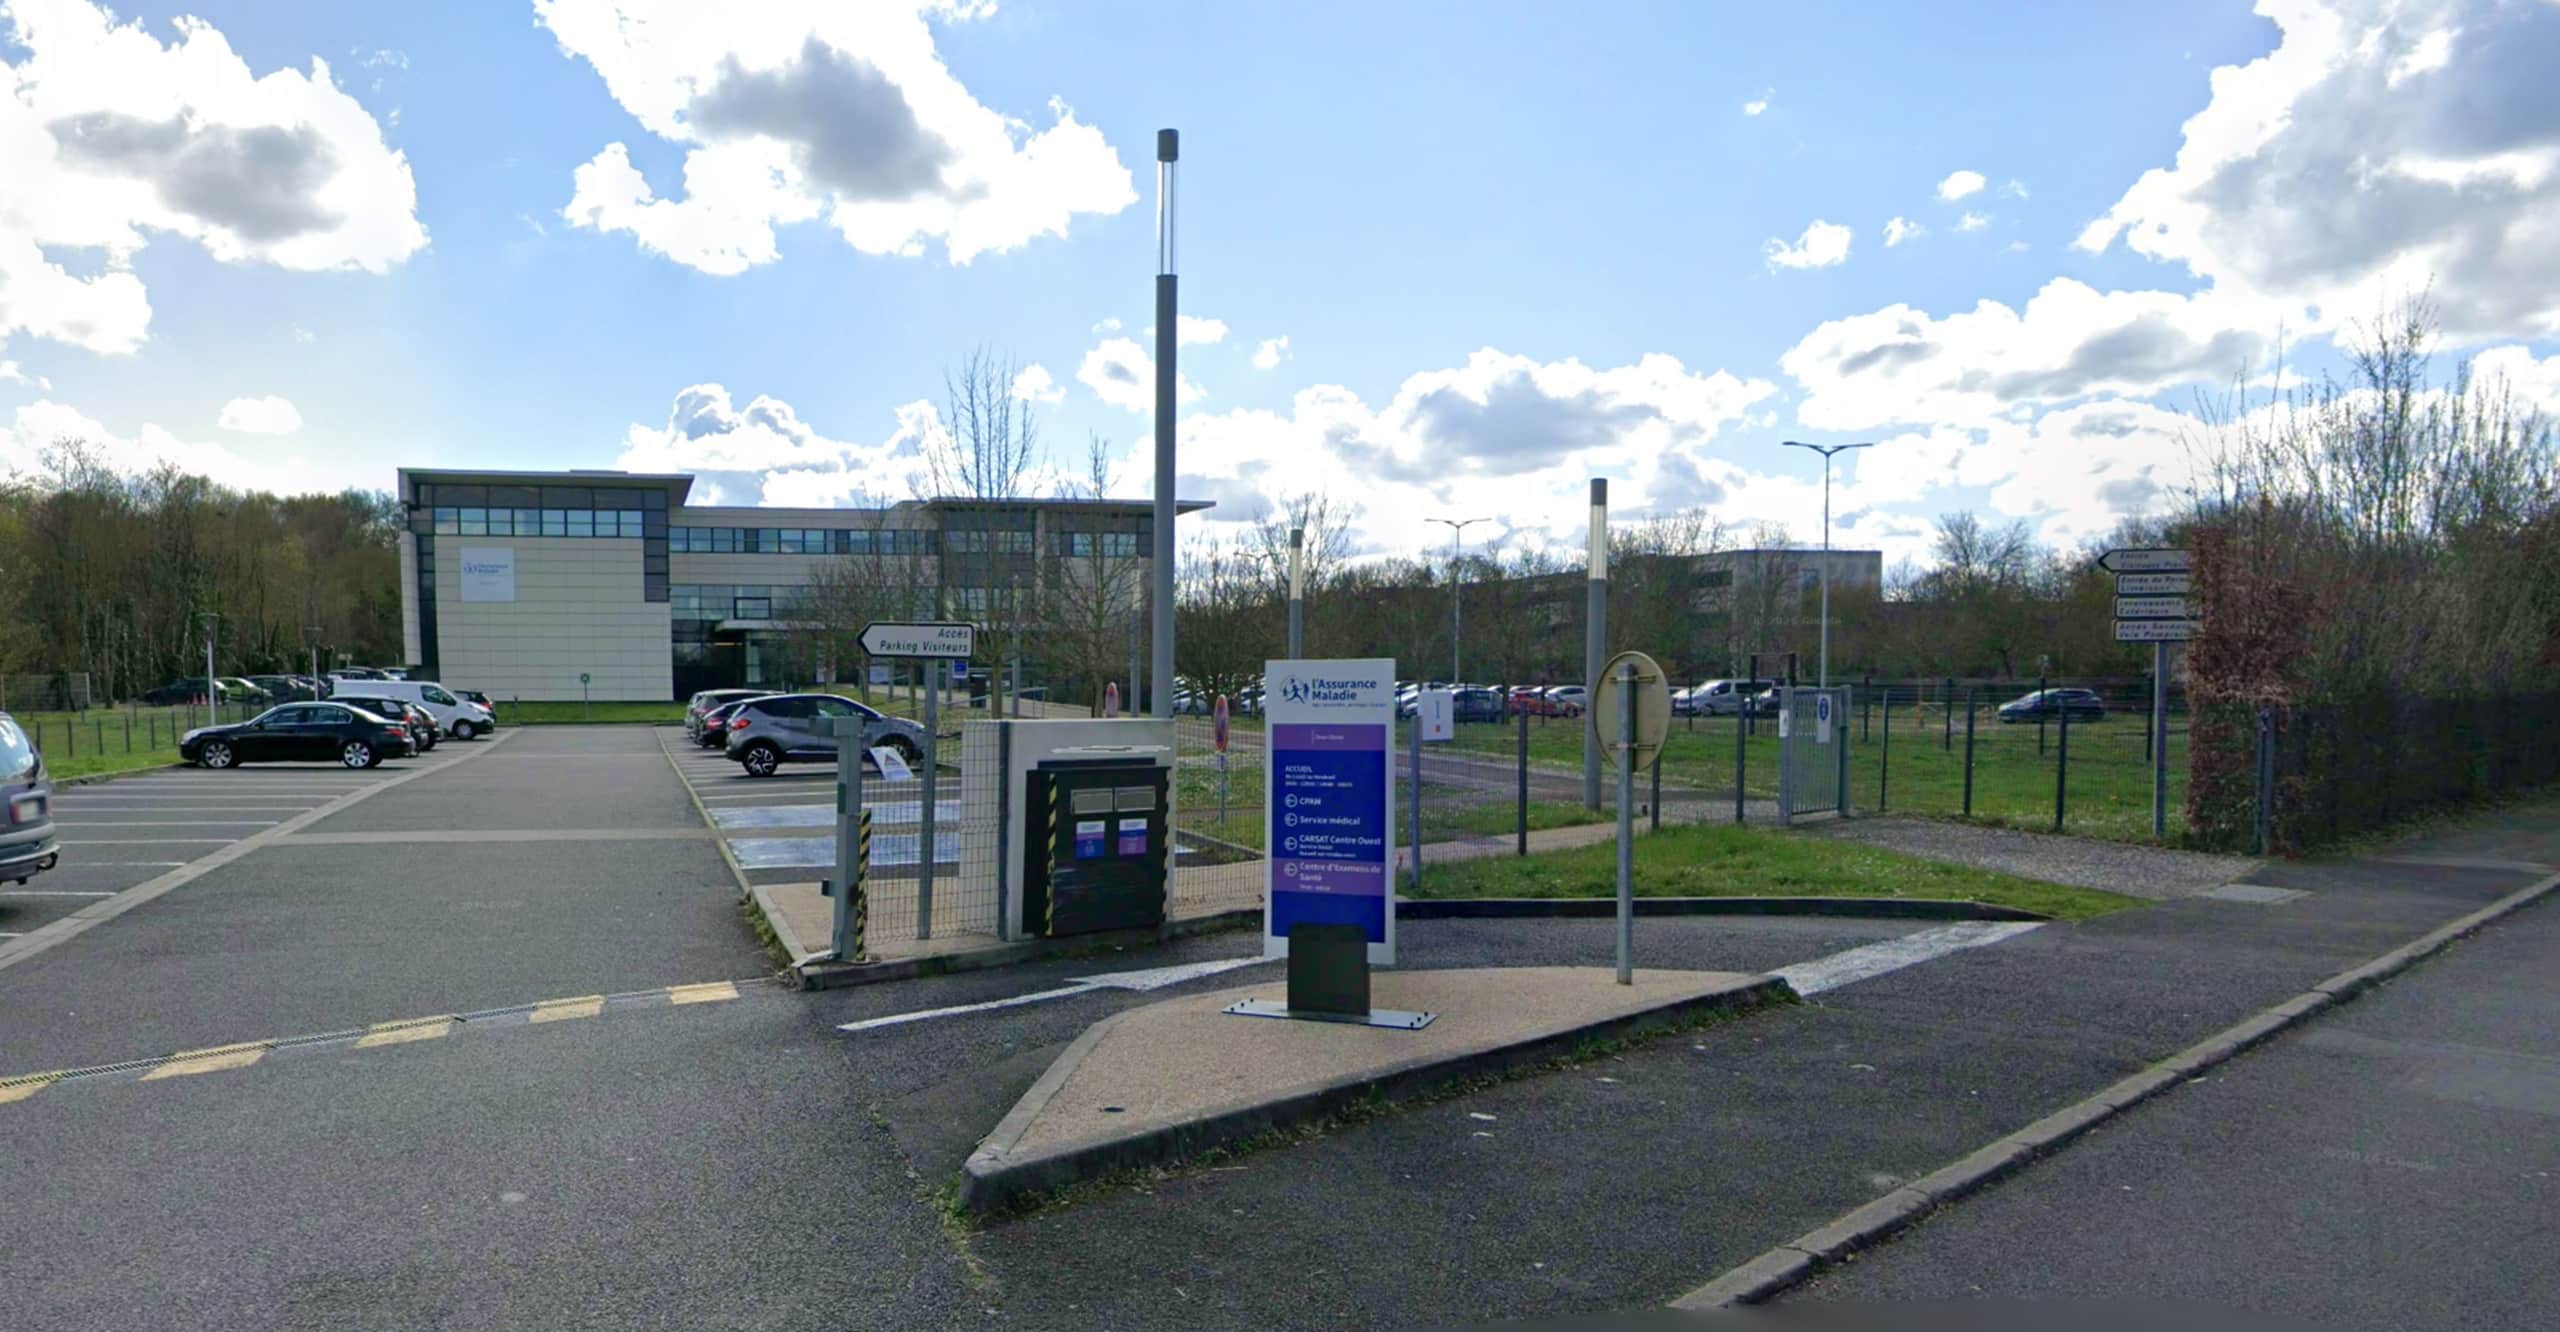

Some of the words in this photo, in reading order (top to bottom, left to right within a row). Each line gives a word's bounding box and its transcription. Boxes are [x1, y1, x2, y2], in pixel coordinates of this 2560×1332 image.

[938, 628, 969, 639] Accès
[880, 640, 918, 654] Parking
[923, 641, 968, 653] Visiteurs
[1312, 678, 1377, 689] l'Assurance
[1312, 690, 1357, 701] Maladie
[1299, 797, 1321, 806] CPAM
[1299, 815, 1328, 825] Service
[1329, 815, 1361, 826] médical
[1299, 834, 1329, 843] CARSAT
[1330, 836, 1356, 845] Centre
[1358, 837, 1381, 845] Ouest
[1300, 862, 1325, 872] Centre
[1371, 865, 1381, 873] de
[1300, 872, 1322, 881] Santé
